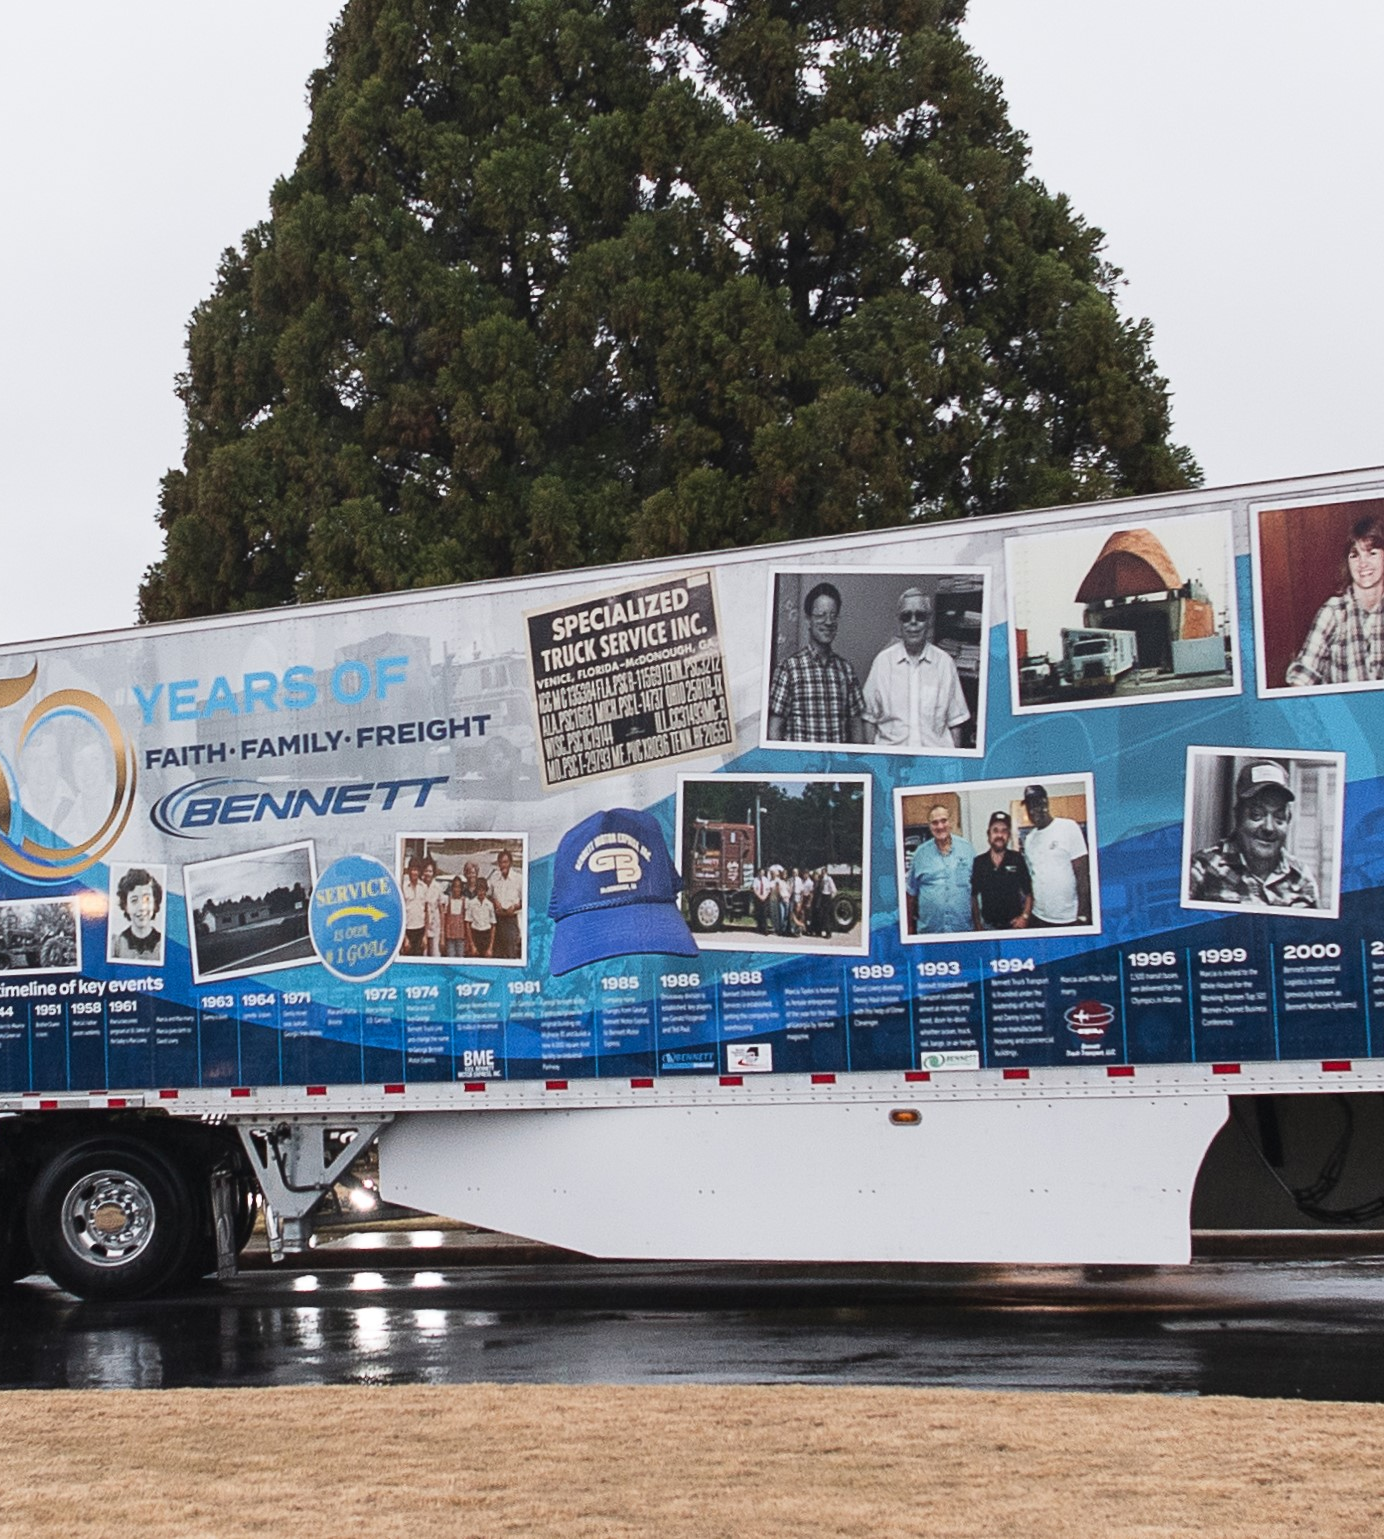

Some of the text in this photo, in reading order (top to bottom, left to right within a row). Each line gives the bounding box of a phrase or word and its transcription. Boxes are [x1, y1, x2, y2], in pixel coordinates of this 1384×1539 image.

[551, 587, 689, 642] SPECIALIZED
[541, 613, 708, 672] TRUCK SERVICE INC.
[536, 673, 575, 690] VENICE,
[134, 655, 410, 726] YEARS OF
[145, 714, 492, 769] FAITH FAMILY FREIGHT
[178, 775, 451, 829] BENNETT
[315, 877, 392, 908] SERVICE
[1128, 951, 1176, 967] 1996
[1197, 948, 1247, 964] 1999
[1283, 943, 1341, 960] 2000
[851, 964, 895, 979] 1989
[916, 961, 961, 977] 1993
[989, 957, 1035, 973] 1994
[600, 976, 640, 990] 1985
[660, 973, 700, 988] 1986
[721, 970, 763, 985] 1988
[58, 979, 76, 995] of
[78, 978, 107, 997] key
[109, 976, 165, 992] events
[405, 986, 439, 999] 1974
[456, 983, 490, 997] 1977
[507, 981, 541, 994] 1981
[201, 995, 234, 1008] 1963
[241, 993, 276, 1006] 1964
[281, 991, 311, 1005] 1971
[364, 988, 397, 1001] 1972
[35, 1003, 62, 1016] 1951
[71, 1001, 102, 1014] 1958
[109, 1000, 138, 1013] 1961
[463, 1049, 495, 1067] BME
